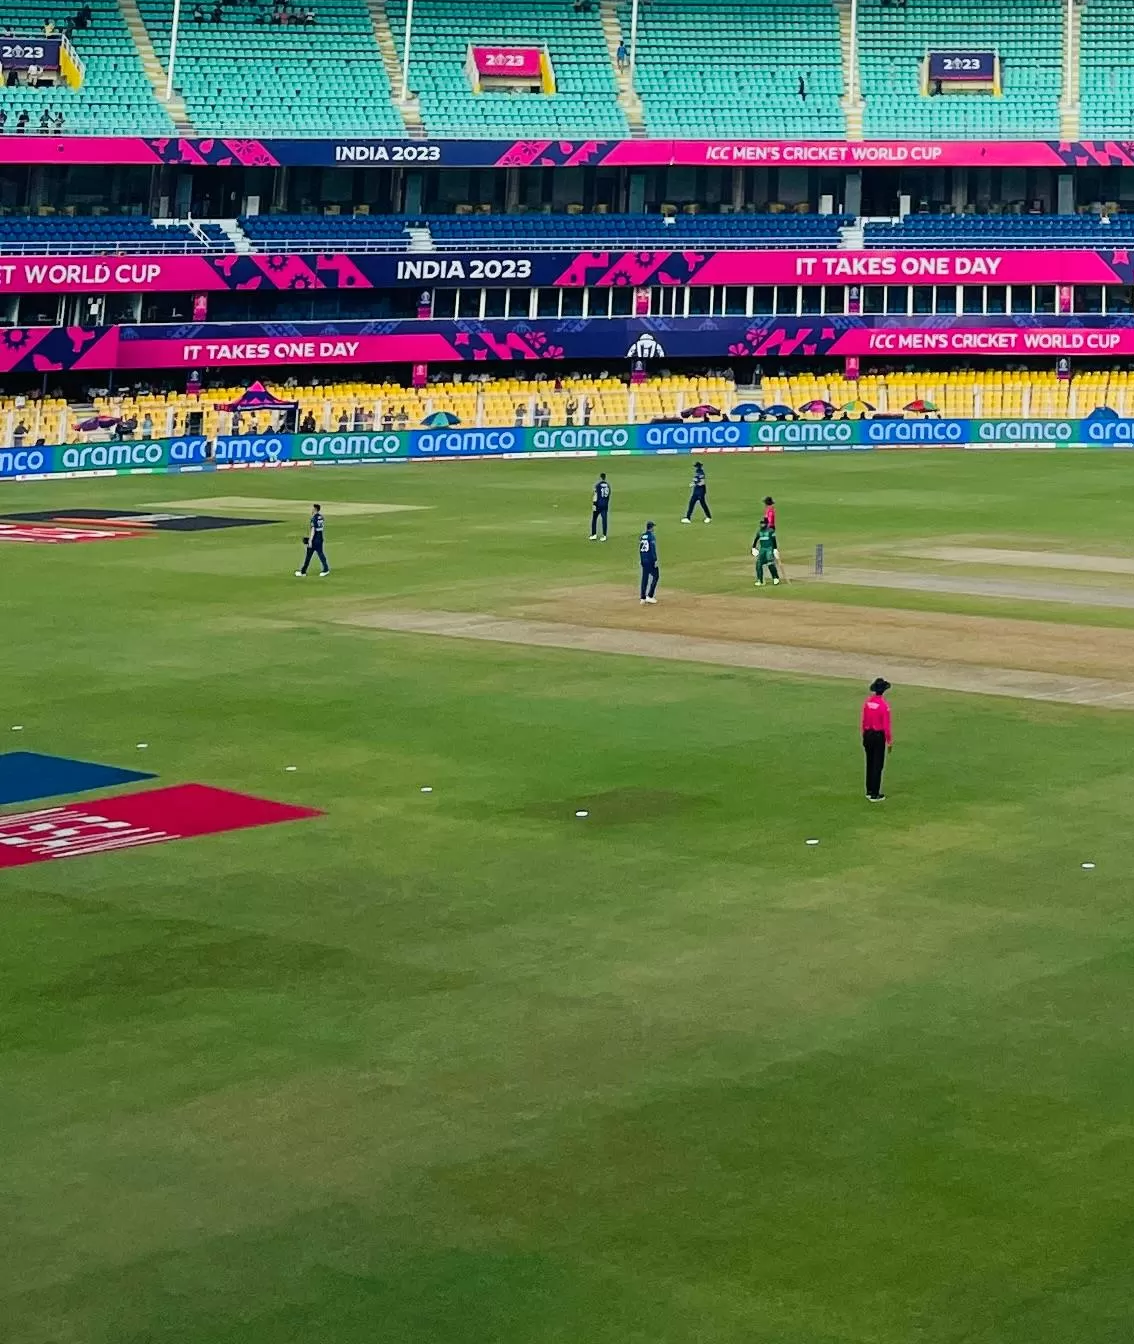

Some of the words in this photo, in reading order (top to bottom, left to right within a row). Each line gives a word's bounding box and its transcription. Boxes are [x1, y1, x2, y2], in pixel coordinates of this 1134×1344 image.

[335, 146, 389, 161] INDIA
[391, 146, 441, 161] 2023
[706, 146, 730, 161] ICC
[732, 146, 780, 161] MEN'S
[782, 146, 849, 161] CRICKET
[851, 146, 909, 161] WORLD
[910, 146, 942, 161] CUP
[24, 264, 111, 285] WORLD
[115, 264, 161, 284] CUP
[397, 260, 466, 280] INDIA
[469, 259, 532, 279] 2023
[796, 257, 818, 276] IT
[822, 257, 897, 276] TAKES
[901, 257, 950, 275] ONE
[955, 257, 1002, 275] DAY
[183, 345, 203, 360] IT
[206, 343, 270, 360] TAKES
[273, 342, 315, 358] ONE
[319, 341, 360, 357] DAY
[869, 334, 896, 349] ICC
[898, 333, 949, 349] MEN'S
[951, 333, 1018, 349] CRICKET
[1023, 333, 1084, 349] WORLD
[1086, 333, 1121, 349] CUP
[417, 431, 516, 452] aramco
[532, 428, 629, 449] aramco
[645, 424, 741, 446] aramco
[757, 422, 852, 442] aramco
[868, 422, 962, 441] aramco
[979, 422, 1072, 441] aramco
[301, 434, 400, 456] aramco
[62, 443, 162, 468] aramco
